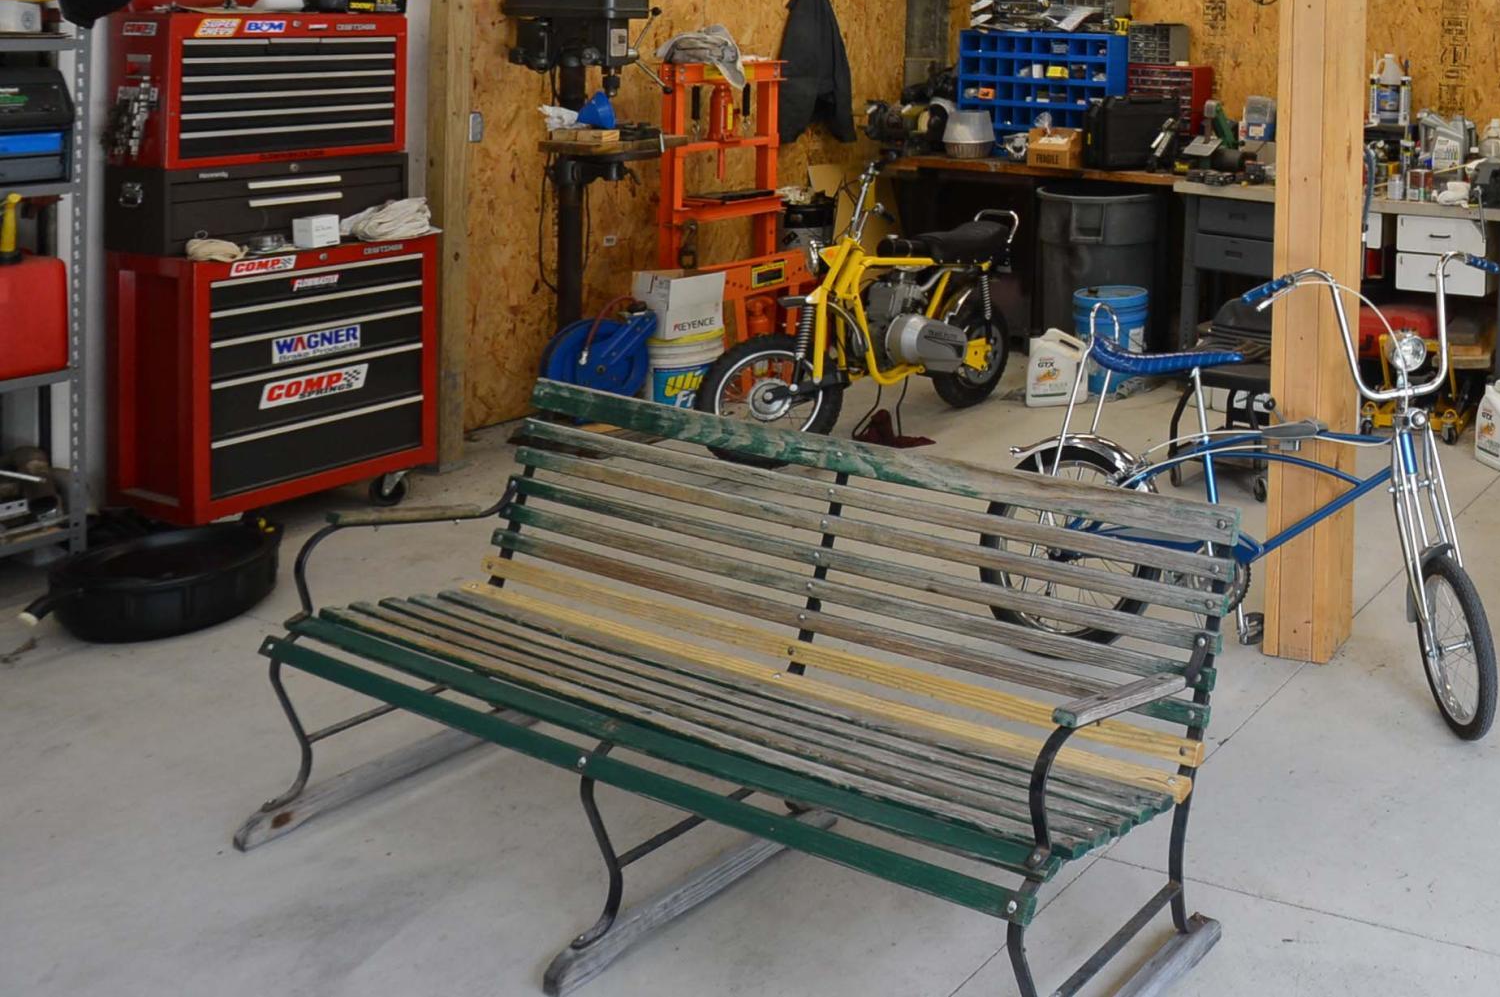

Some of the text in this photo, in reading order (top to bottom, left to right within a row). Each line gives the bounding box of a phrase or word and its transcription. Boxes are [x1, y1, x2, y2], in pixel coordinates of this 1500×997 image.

[234, 258, 282, 273] COMP
[673, 316, 716, 332] KEYENCE
[275, 326, 358, 355] WAGNER
[279, 342, 358, 362] Brake Products
[266, 372, 343, 402] COMP
[299, 382, 353, 399] SPRINGS
